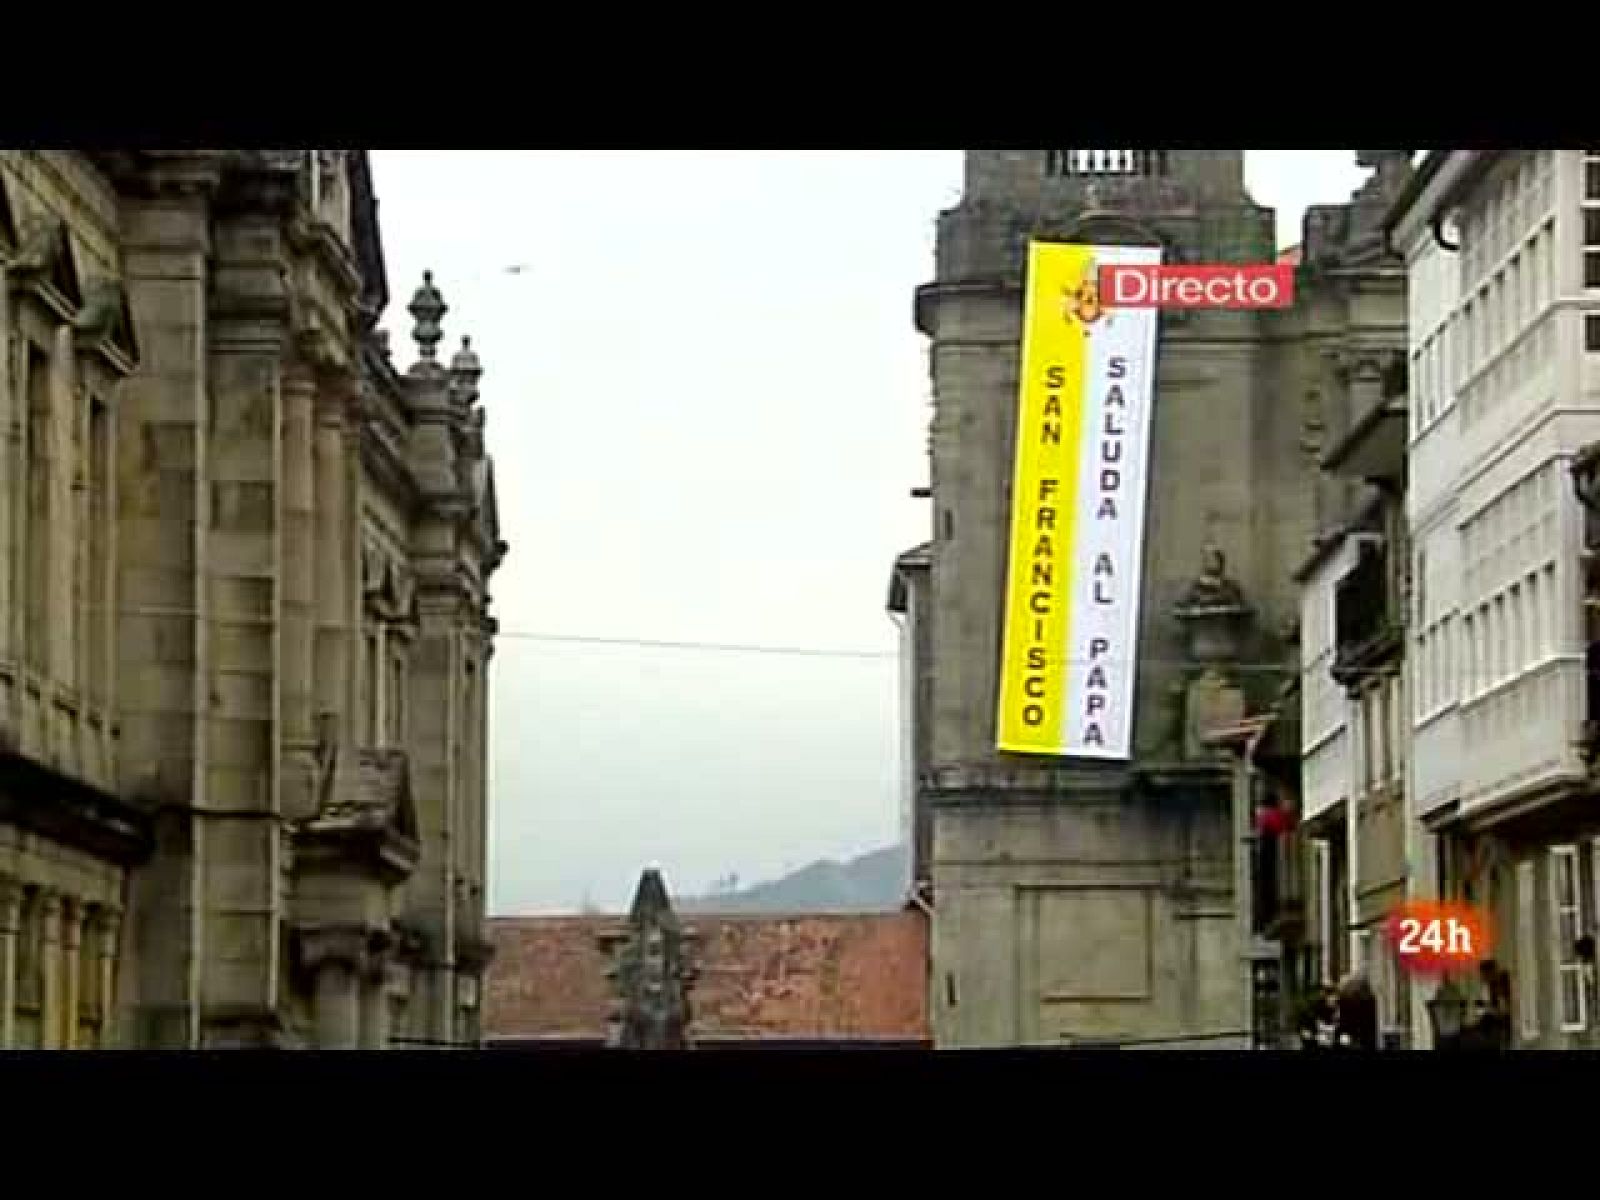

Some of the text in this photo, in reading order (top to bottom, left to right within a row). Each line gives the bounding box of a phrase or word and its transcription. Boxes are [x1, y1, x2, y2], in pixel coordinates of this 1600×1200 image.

[1022, 366, 1065, 726] SAN FRANCISCO
[1083, 356, 1127, 746] SALUDA AL PAPA
